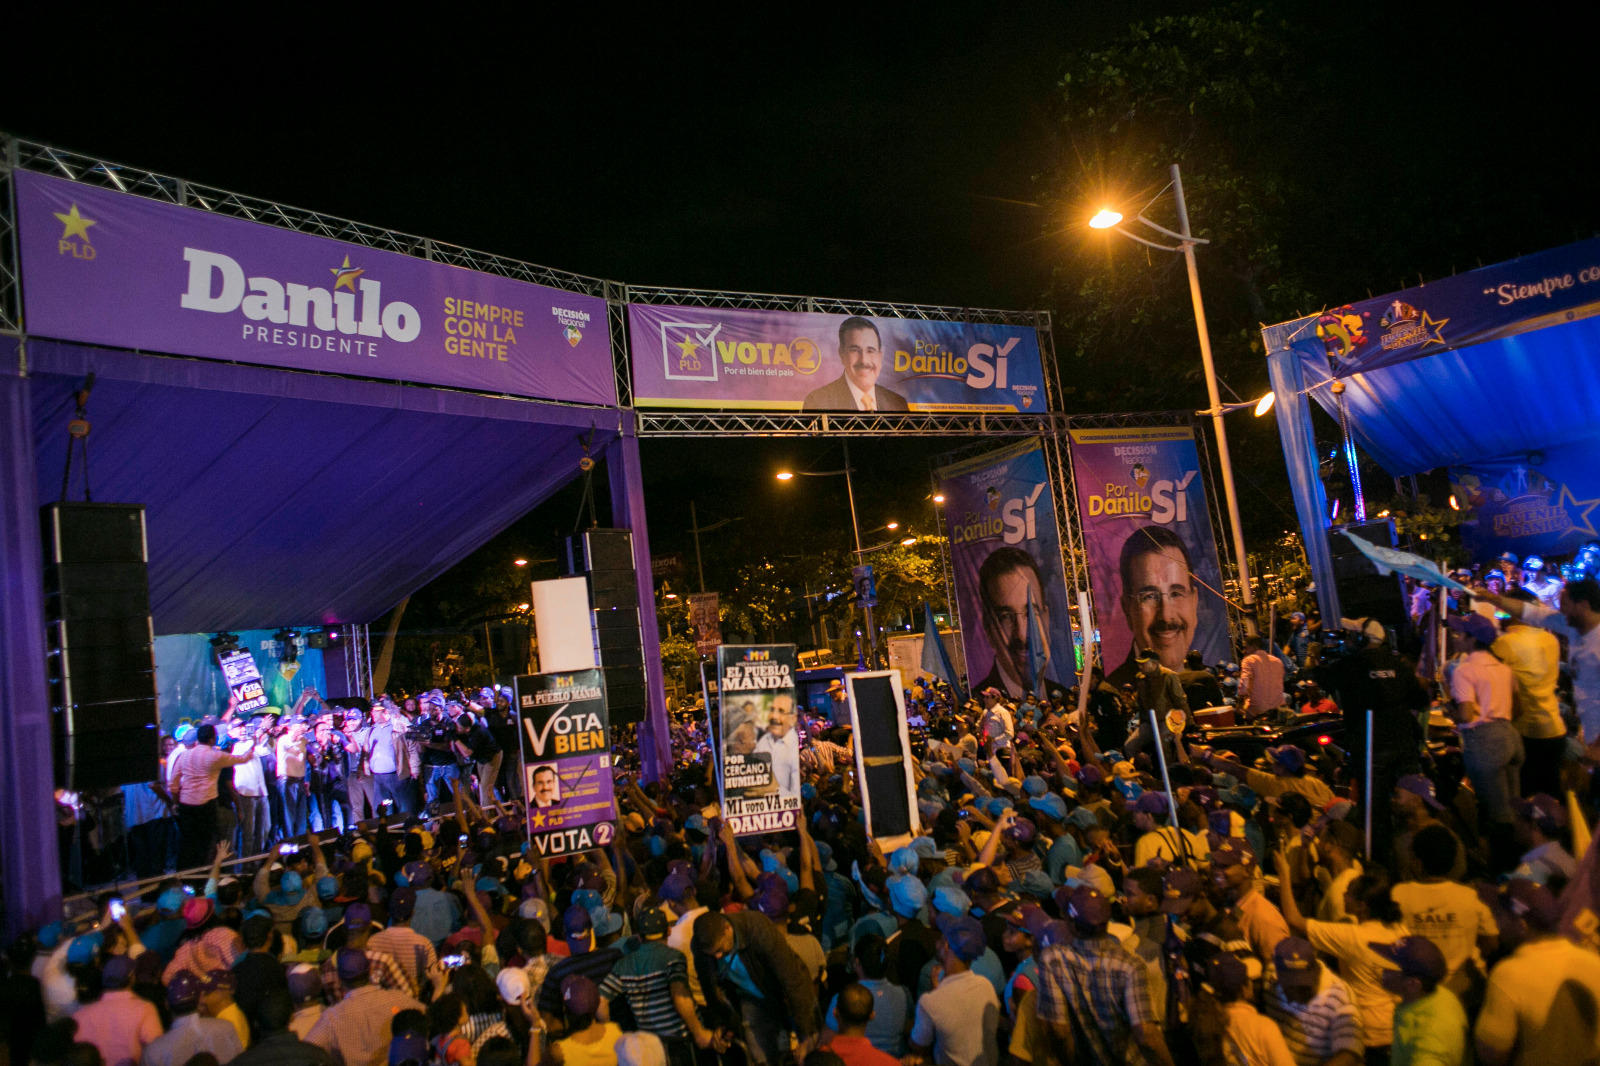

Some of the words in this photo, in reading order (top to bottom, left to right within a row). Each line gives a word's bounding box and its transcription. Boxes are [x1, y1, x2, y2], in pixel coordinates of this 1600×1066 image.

[58, 239, 96, 261] PLD
[181, 247, 421, 342] Danilo
[444, 297, 524, 327] SIEMPRE
[552, 306, 590, 322] DECISIÓN
[444, 316, 486, 339] CON
[493, 325, 517, 344] LA
[557, 316, 586, 328] Nacional
[242, 324, 379, 358] PRESIDENTE
[445, 336, 508, 361] GENTE
[915, 340, 940, 355] Por
[716, 341, 793, 365] VOTA
[796, 343, 816, 368] 2
[894, 350, 968, 374] Danilo
[966, 337, 1021, 389] Sí
[679, 360, 701, 371] PLD
[724, 366, 738, 375] Por
[739, 367, 747, 375] el
[747, 367, 764, 376] bien
[765, 368, 778, 377] del
[1114, 444, 1157, 456] DECISIÓN
[1088, 491, 1152, 516] Danilo
[1151, 470, 1198, 524] Sí
[1106, 483, 1128, 497] Por
[953, 515, 1004, 544] Danilo
[1002, 482, 1046, 544] Sí
[1494, 505, 1568, 531] JUVENIL
[1510, 516, 1573, 538] DANILO
[726, 666, 743, 678] EL
[744, 664, 790, 677] PUEBLO
[1369, 670, 1396, 679] CREW
[721, 675, 795, 691] MANDA
[521, 695, 534, 706] EL
[535, 690, 570, 704] PUEBLO
[571, 687, 602, 701] MANDA
[237, 699, 260, 713] VOTA
[523, 703, 603, 756] VOTA
[554, 730, 605, 754] BIEN
[724, 755, 745, 766] POR
[724, 763, 765, 776] CERCANO
[765, 762, 772, 772] Y
[725, 774, 770, 789] HUMILDE
[726, 799, 743, 815] MI
[746, 802, 765, 812] VOTO
[784, 798, 798, 809] POR
[548, 817, 564, 826] PLD
[728, 811, 795, 834] DANILO
[534, 828, 593, 856] VOTA
[597, 825, 611, 845] 2
[1413, 912, 1457, 924] SALE
